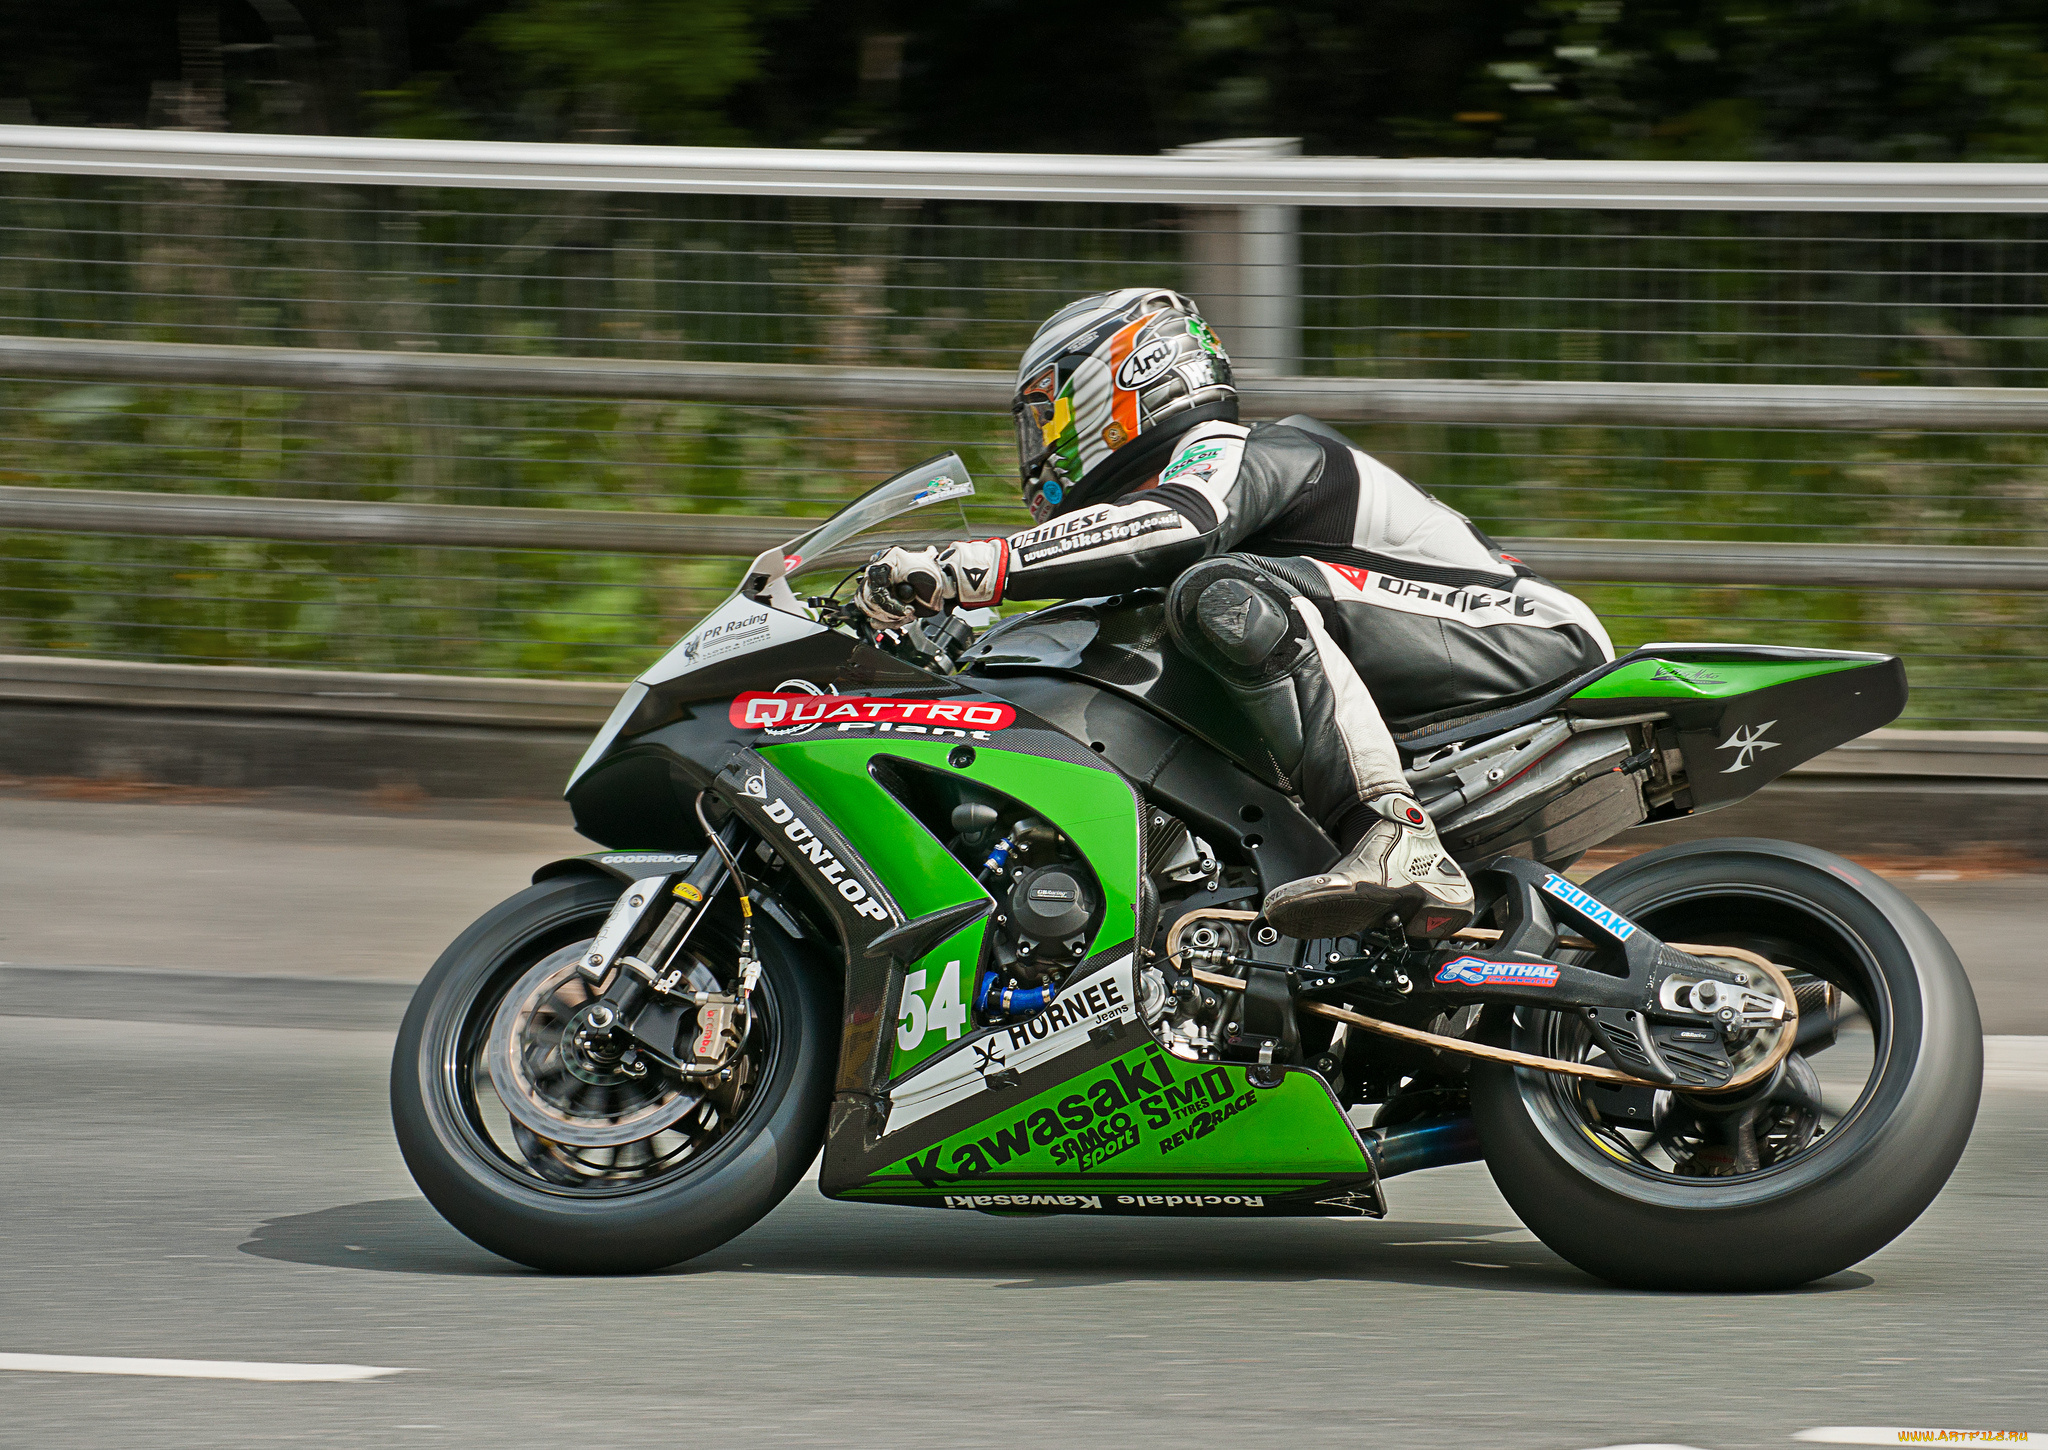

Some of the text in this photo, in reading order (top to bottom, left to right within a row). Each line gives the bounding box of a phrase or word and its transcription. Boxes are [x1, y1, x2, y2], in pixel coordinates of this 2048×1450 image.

[1126, 341, 1172, 387] Arai
[1023, 513, 1179, 563] www.bikestop.co.uk
[703, 612, 769, 640] PR Racing
[745, 698, 1003, 727] QUATTRO
[600, 854, 698, 864] GOODRIDGE
[762, 797, 888, 921] DUNLOP
[1545, 875, 1634, 939] TSUBAKI
[1444, 959, 1557, 981] RENTHAL
[897, 960, 966, 1051] 54
[1006, 977, 1125, 1051] HORNEE
[1095, 1003, 1129, 1025] Jeans
[699, 1009, 718, 1054] brembo
[905, 1042, 1175, 1189] Kawasaki
[1139, 1066, 1235, 1130] SMD
[1159, 1089, 1258, 1155] REV2RACE
[1172, 1097, 1210, 1121] TYRES
[1049, 1112, 1132, 1166] SAMCO
[944, 1194, 1264, 1209] Rochdale Kawasaki
